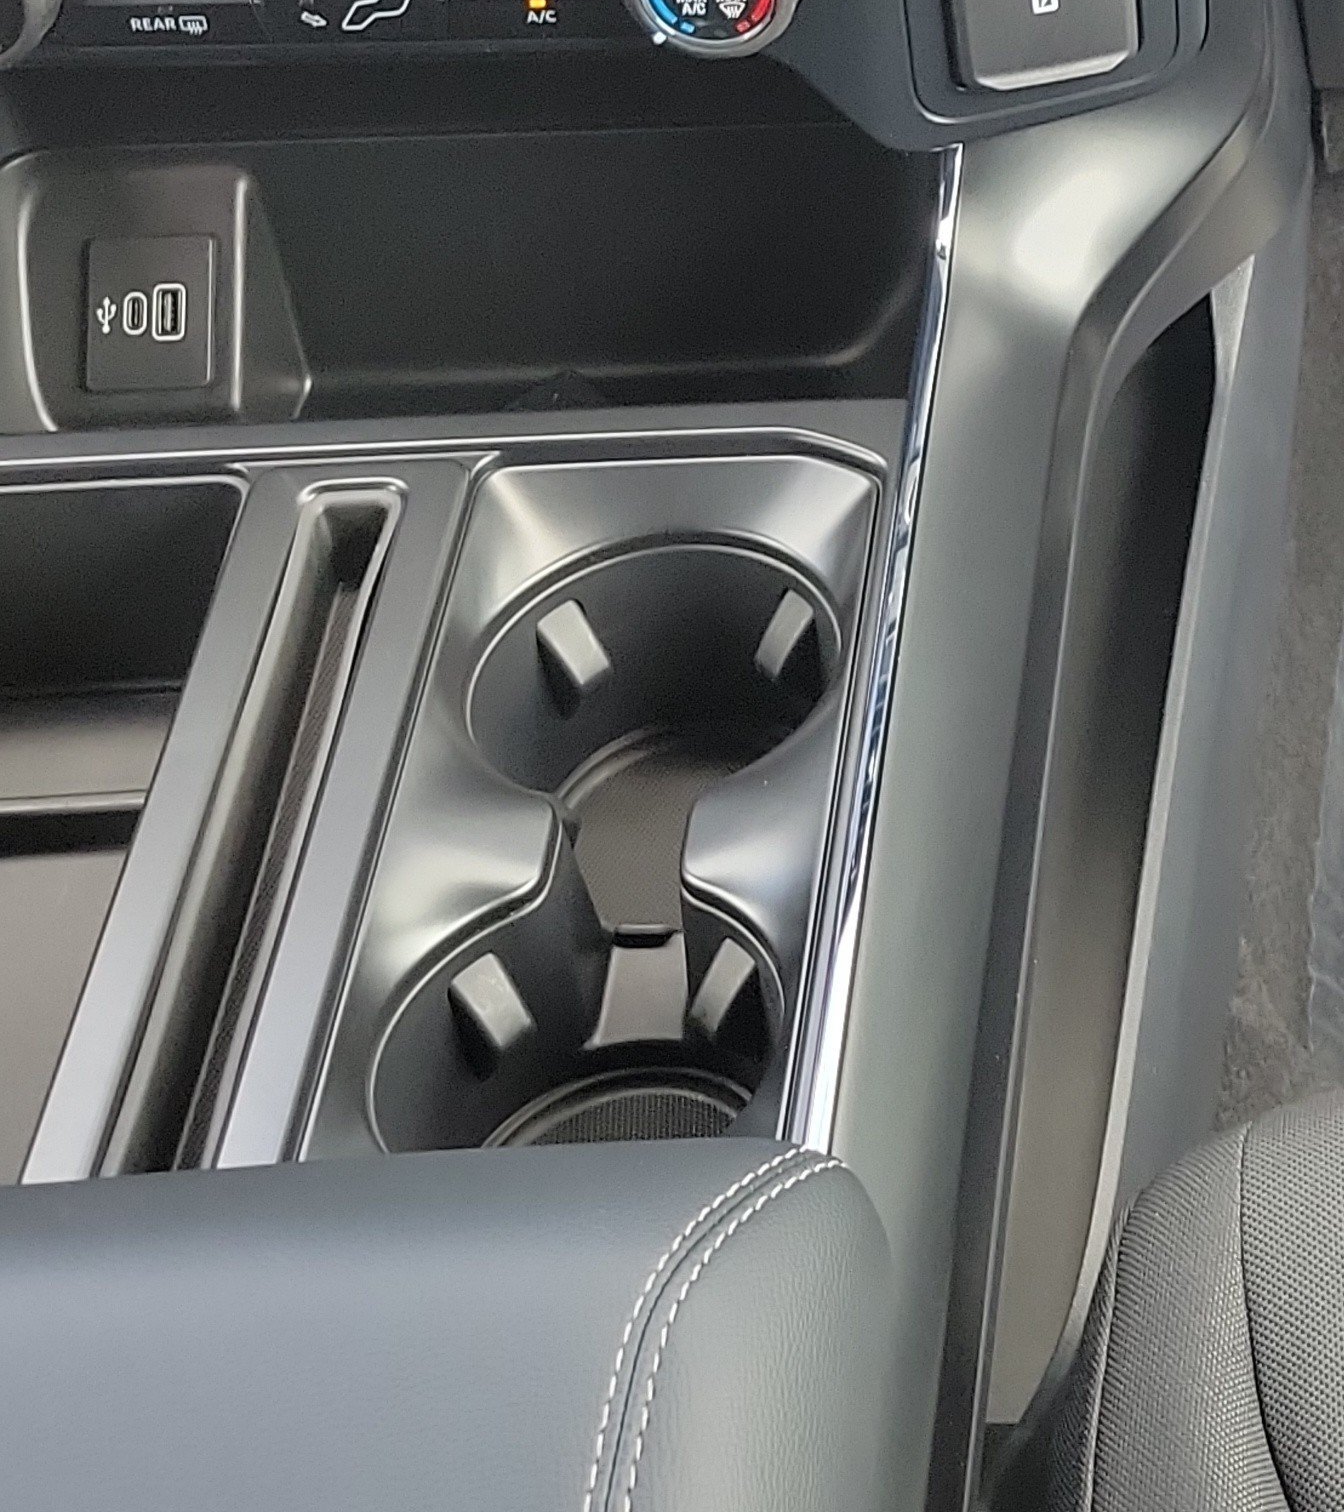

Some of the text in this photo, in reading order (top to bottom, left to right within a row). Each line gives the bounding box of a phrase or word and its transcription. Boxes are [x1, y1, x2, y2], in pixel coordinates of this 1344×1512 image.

[681, 2, 707, 16] A/C
[526, 10, 558, 24] A/C
[130, 17, 177, 32] REAR
